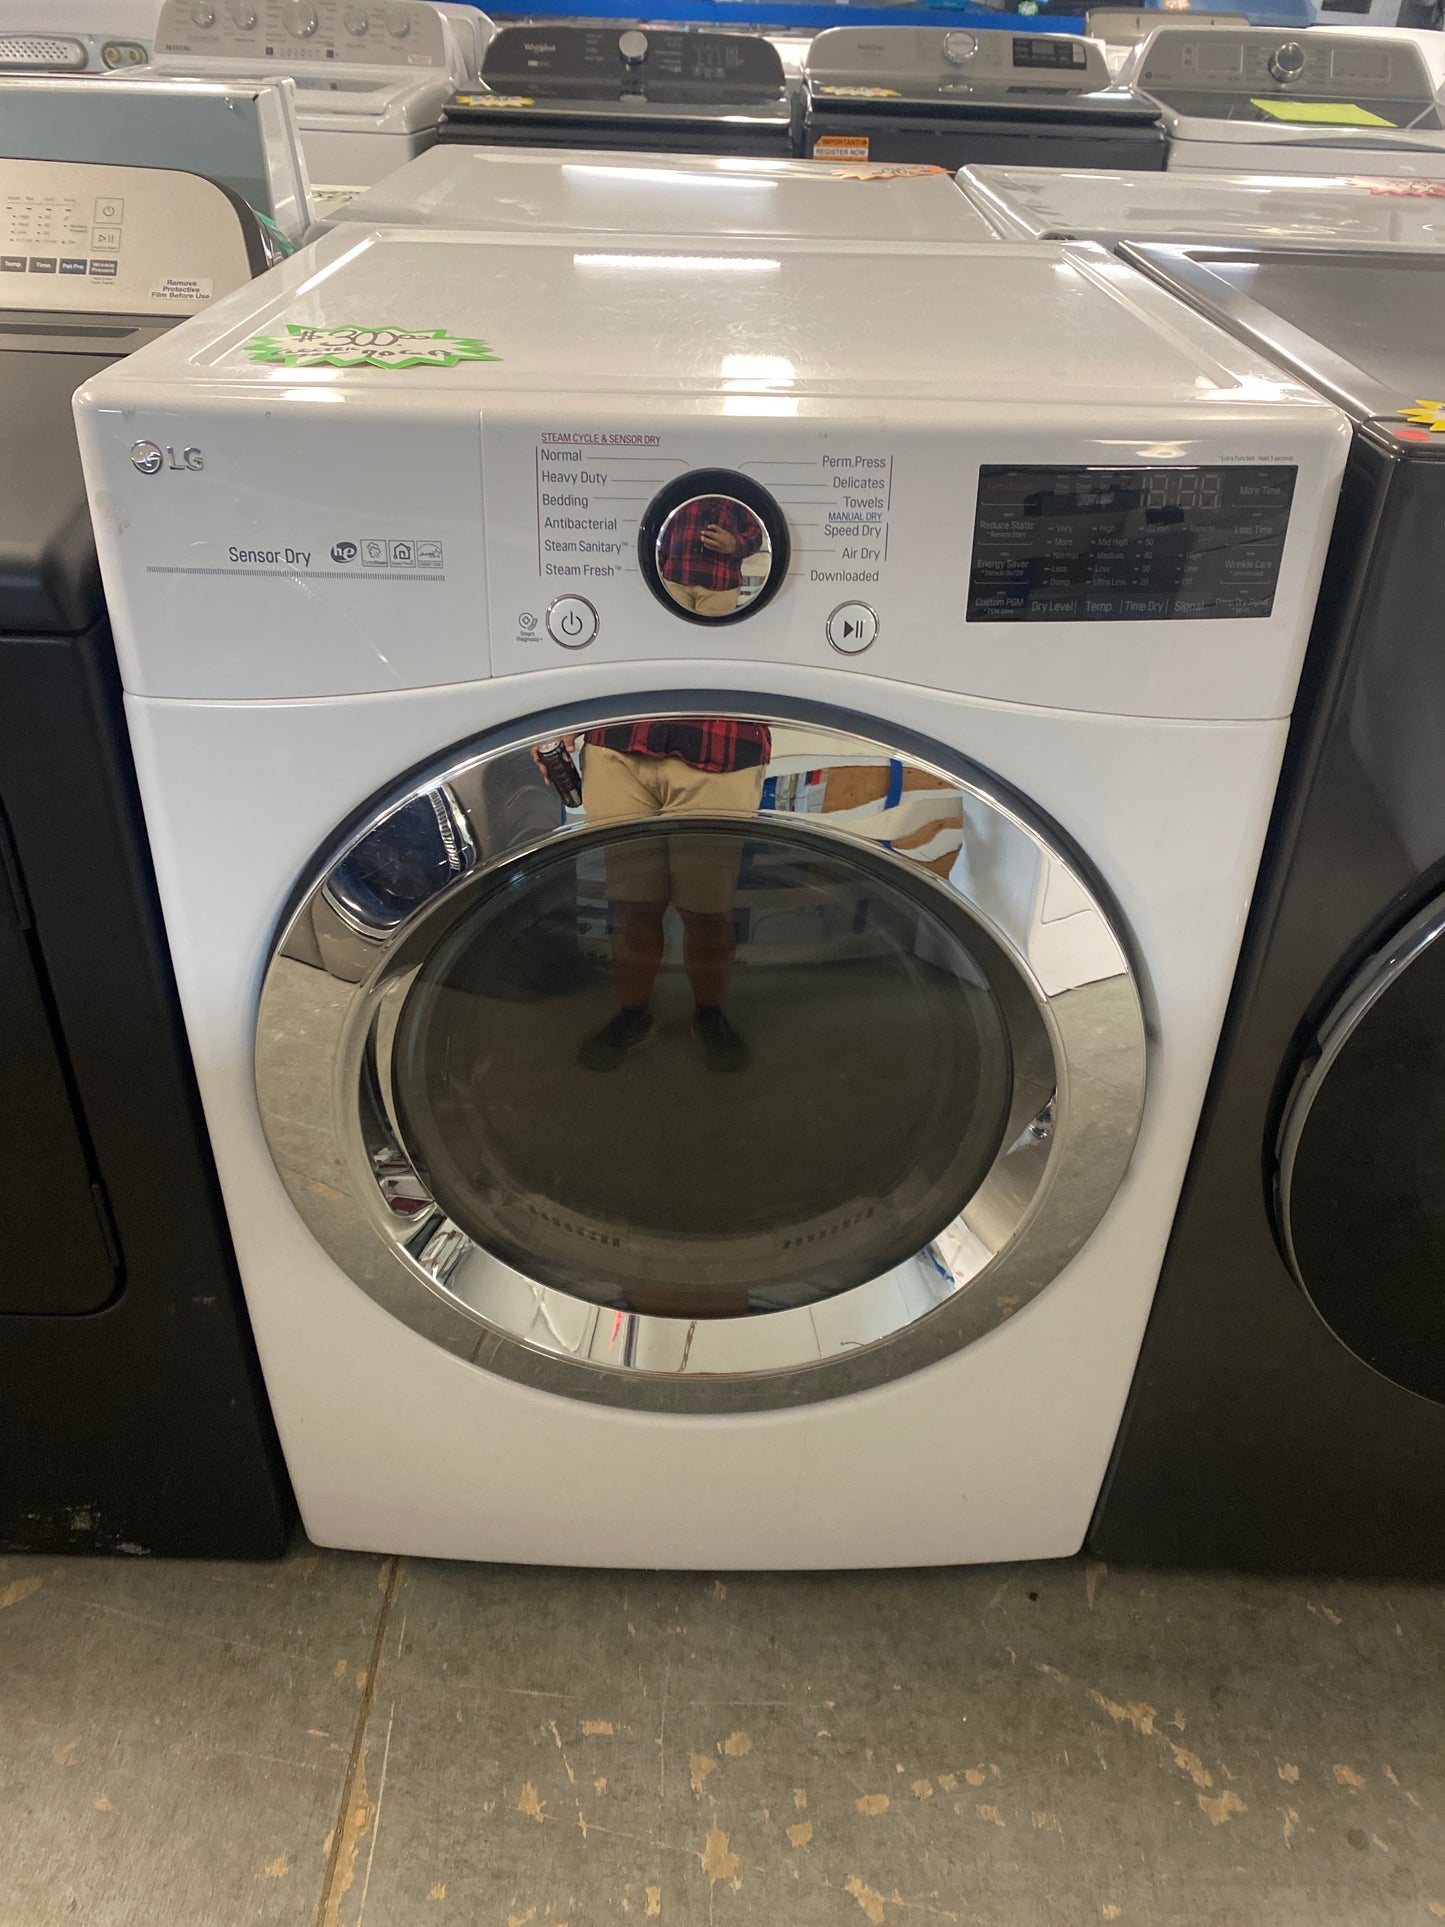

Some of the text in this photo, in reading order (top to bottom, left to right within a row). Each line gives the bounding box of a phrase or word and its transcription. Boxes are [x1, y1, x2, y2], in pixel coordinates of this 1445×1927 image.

[4, 260, 22, 268] Temp
[541, 432, 661, 445] STEAM CYCLE & SENSOR DRY
[166, 445, 204, 471] LG
[540, 450, 582, 462] Normal
[542, 470, 608, 486] Heavy Duty
[833, 476, 885, 489] Delicates
[1240, 486, 1280, 495] More Time
[542, 494, 589, 510] Bedding
[843, 496, 884, 508] Towels
[828, 512, 882, 521] MANUAL DRY
[544, 516, 617, 530] Antibacterial
[980, 520, 1035, 530] Reduce Static
[824, 524, 882, 538] Speed Dry
[1100, 525, 1116, 534] High
[1234, 526, 1273, 534] Less Time
[544, 540, 576, 552] Steam
[1055, 538, 1072, 546] More
[228, 546, 312, 567] Sensor Dry
[842, 547, 880, 562] Air Dry
[546, 563, 580, 576] Steam
[977, 560, 1029, 570] Energy Saver
[1225, 560, 1253, 569] Wrinkle
[810, 570, 880, 582] Downloaded
[1050, 578, 1070, 586] Damp
[975, 598, 1024, 606] Custom PGM
[1032, 601, 1074, 614] Dry Level
[1086, 602, 1113, 614] Temp.
[1126, 601, 1163, 614] Time Dry
[1174, 601, 1205, 613] Signal
